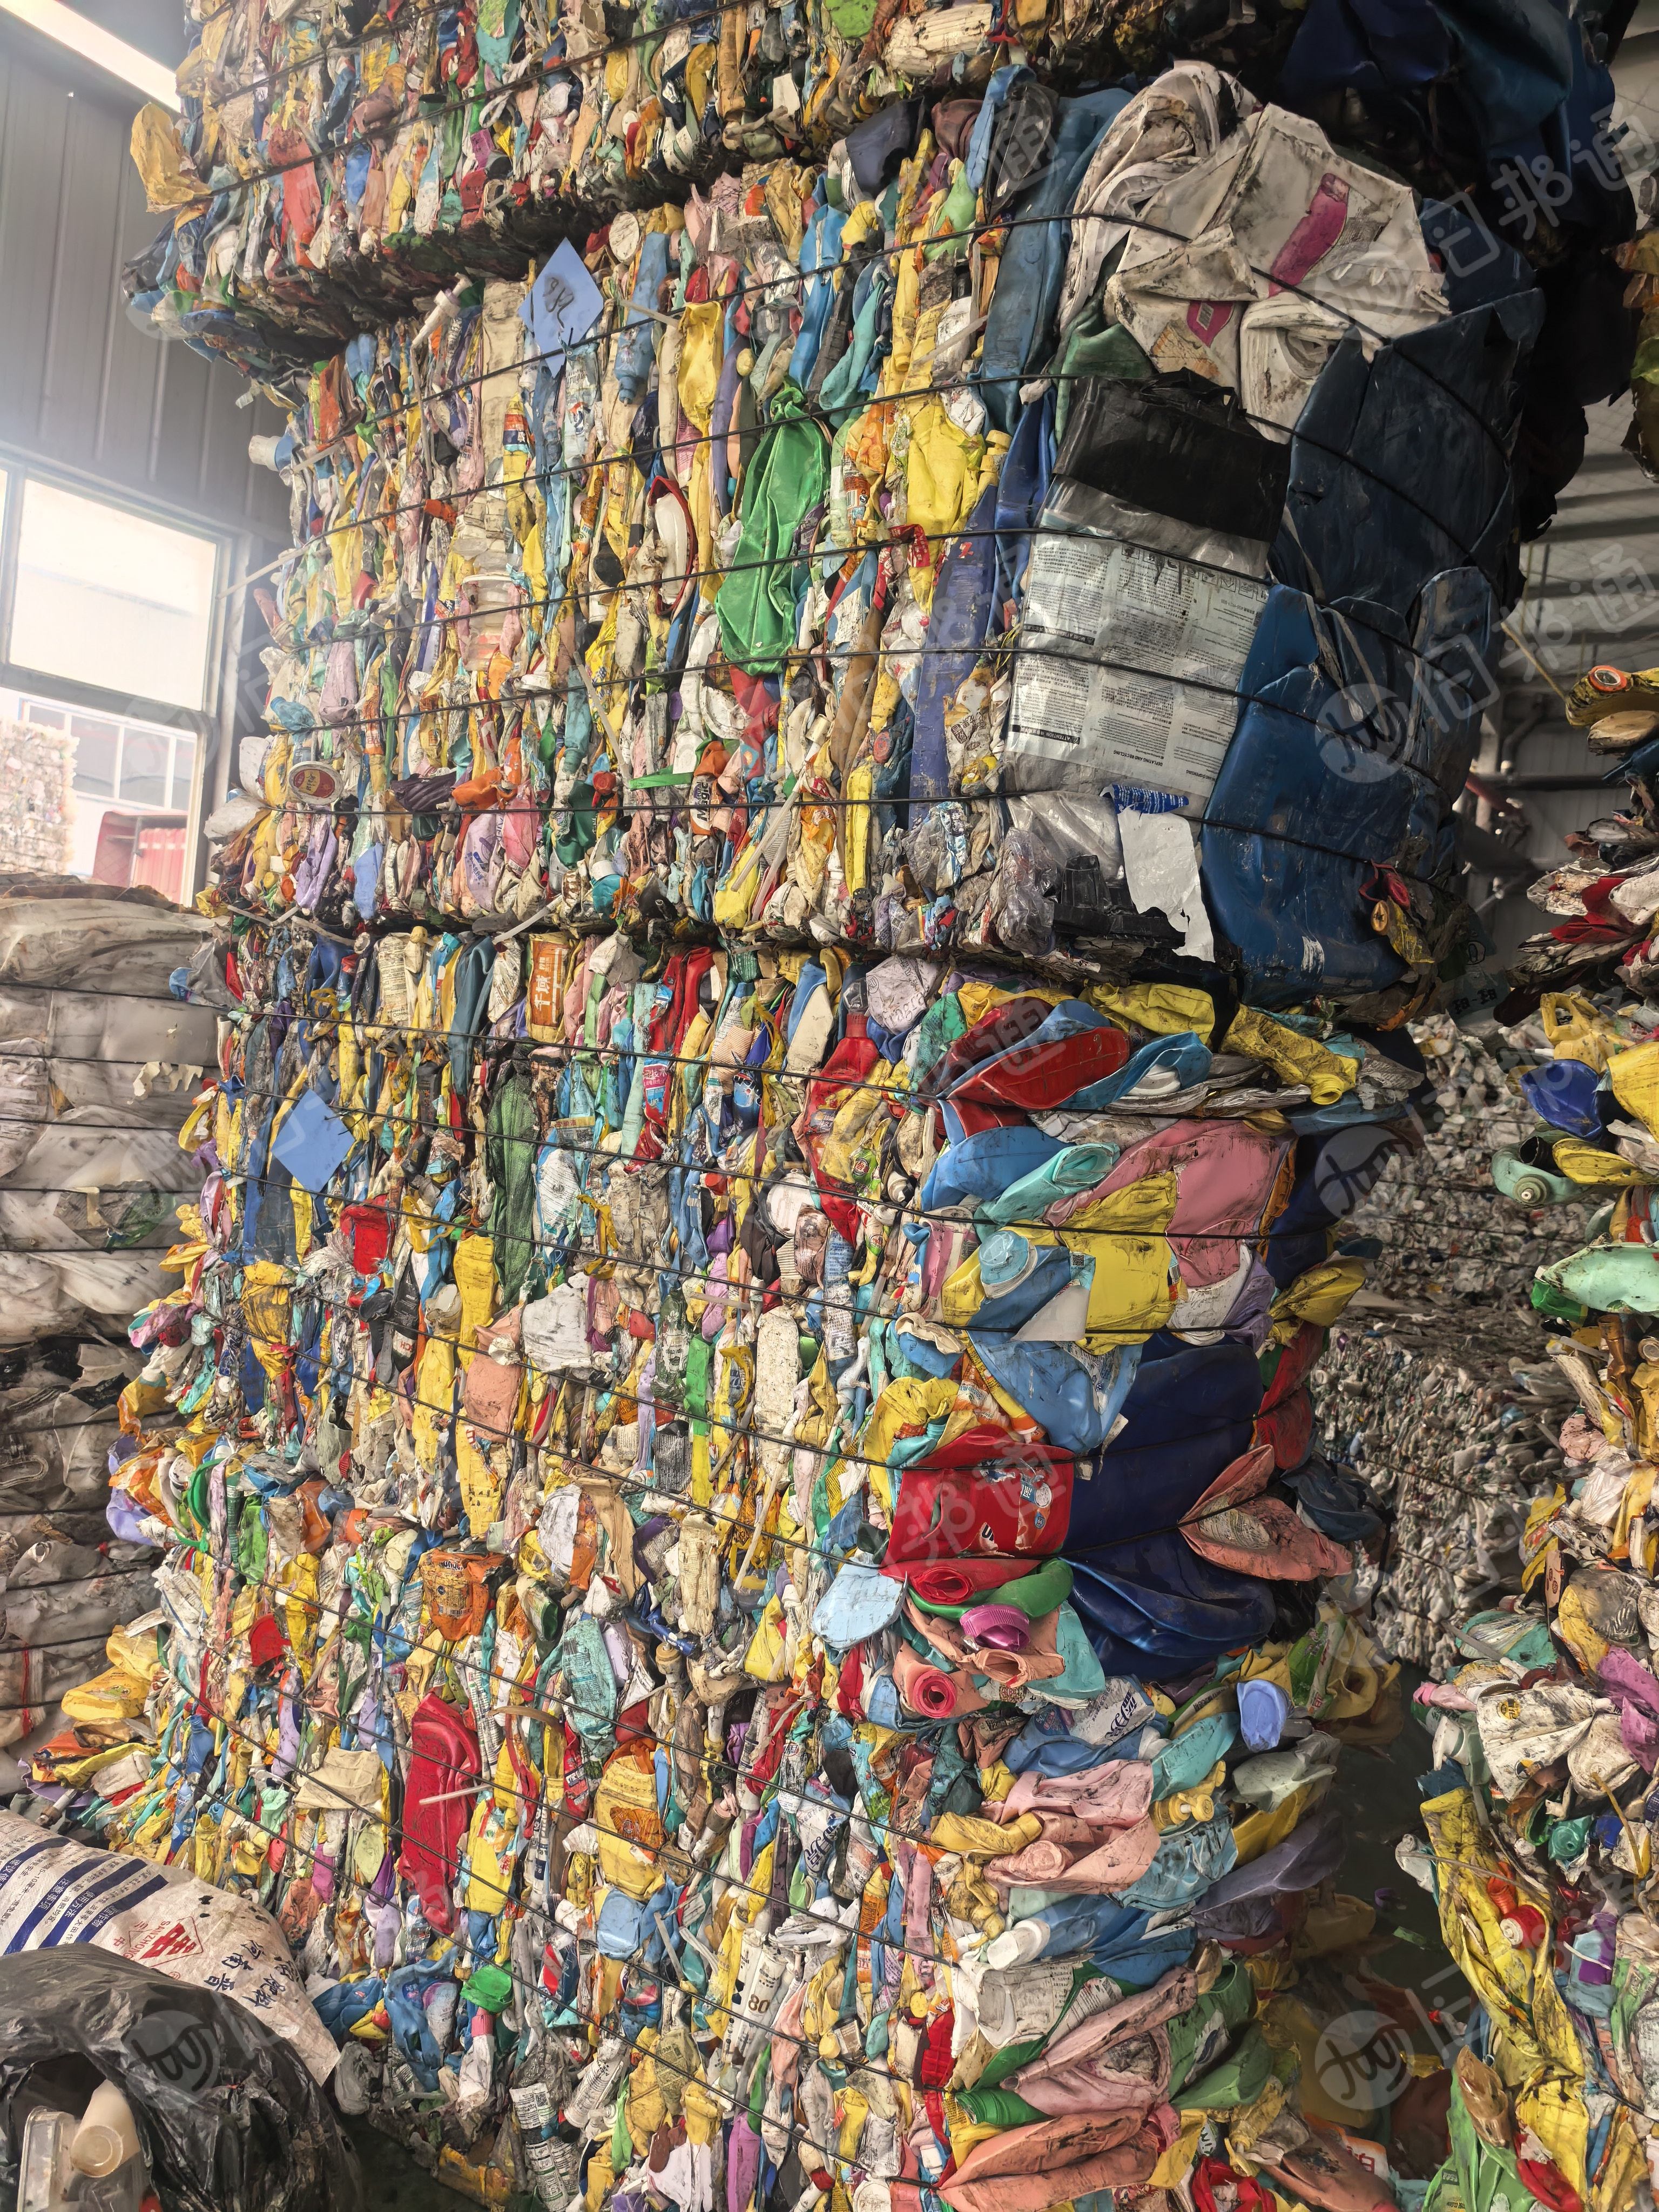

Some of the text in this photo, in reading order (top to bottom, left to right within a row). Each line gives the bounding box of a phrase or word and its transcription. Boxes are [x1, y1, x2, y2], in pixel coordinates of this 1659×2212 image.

[41, 1879, 72, 1911] 注意事项
[748, 1993, 771, 2014] 80
